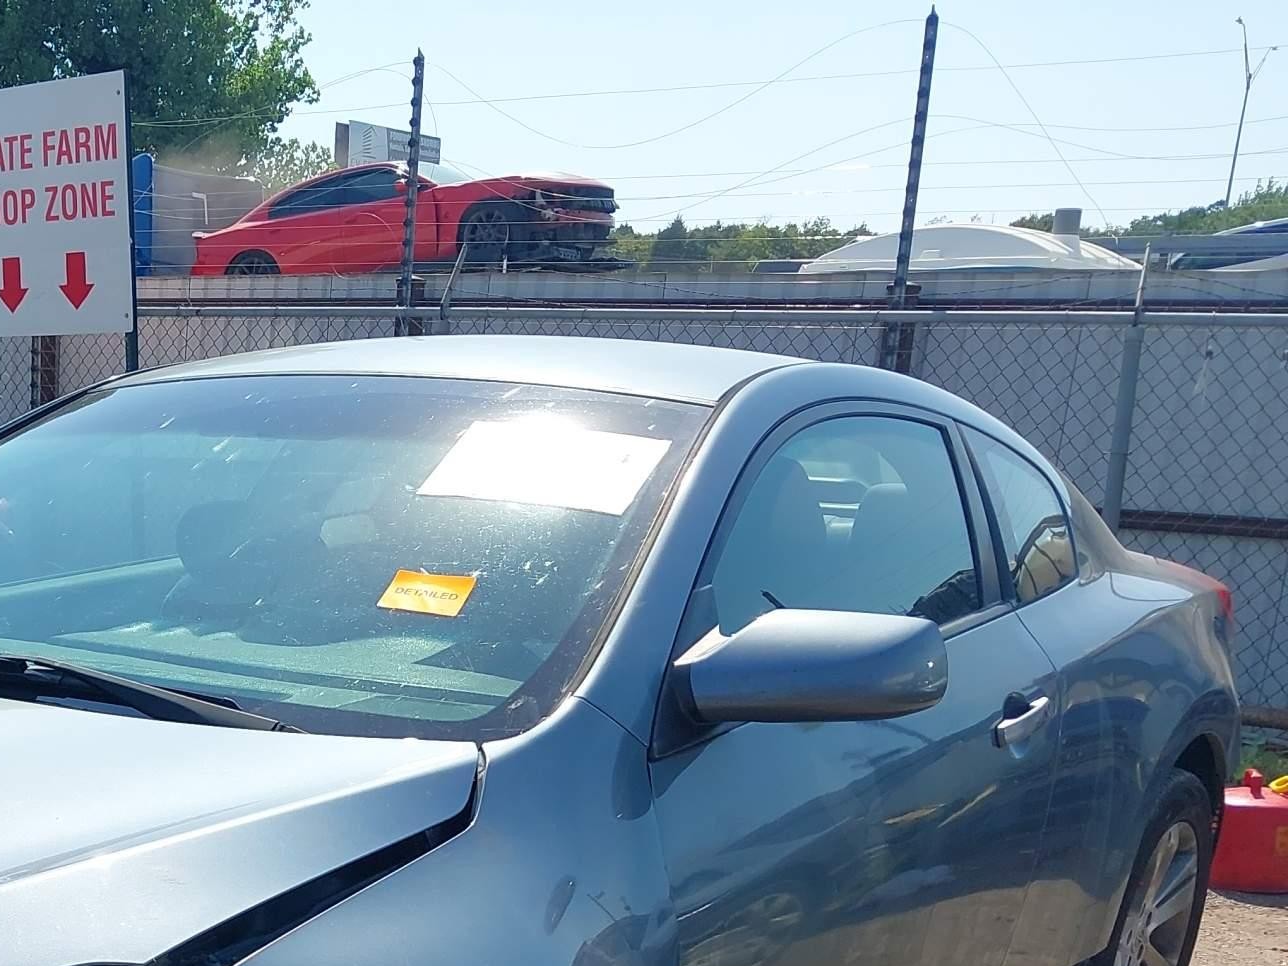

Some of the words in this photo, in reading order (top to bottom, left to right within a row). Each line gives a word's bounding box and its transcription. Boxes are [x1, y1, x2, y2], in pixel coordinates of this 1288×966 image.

[43, 123, 117, 167] FARM
[45, 180, 116, 222] ZONE
[394, 587, 459, 600] DETAILED
